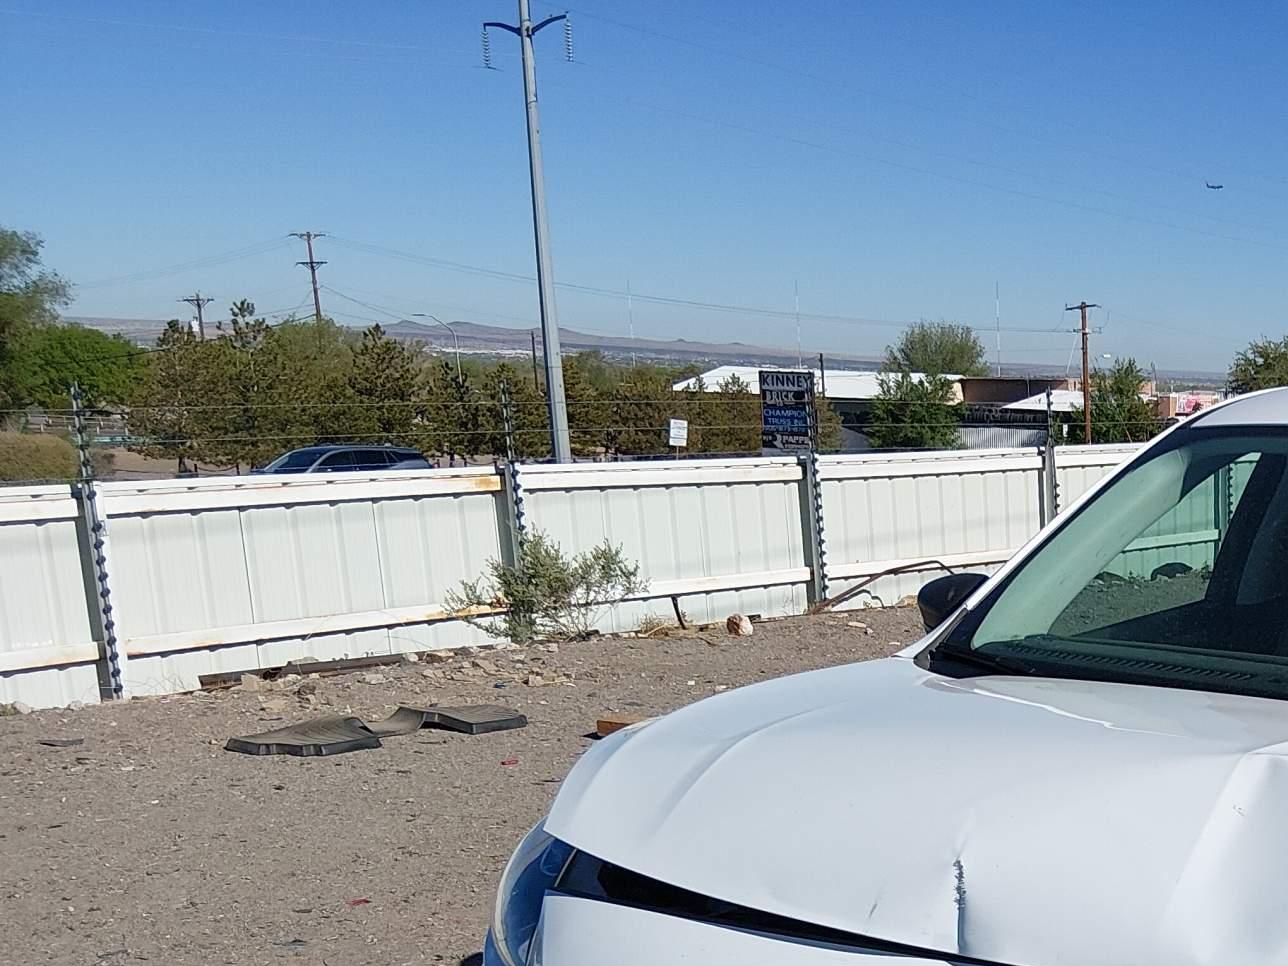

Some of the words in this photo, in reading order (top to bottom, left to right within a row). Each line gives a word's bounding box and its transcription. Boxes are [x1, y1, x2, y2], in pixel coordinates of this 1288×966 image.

[762, 374, 810, 389] KINNEY
[766, 391, 795, 401] BRICK
[764, 409, 808, 418] CHAMPION
